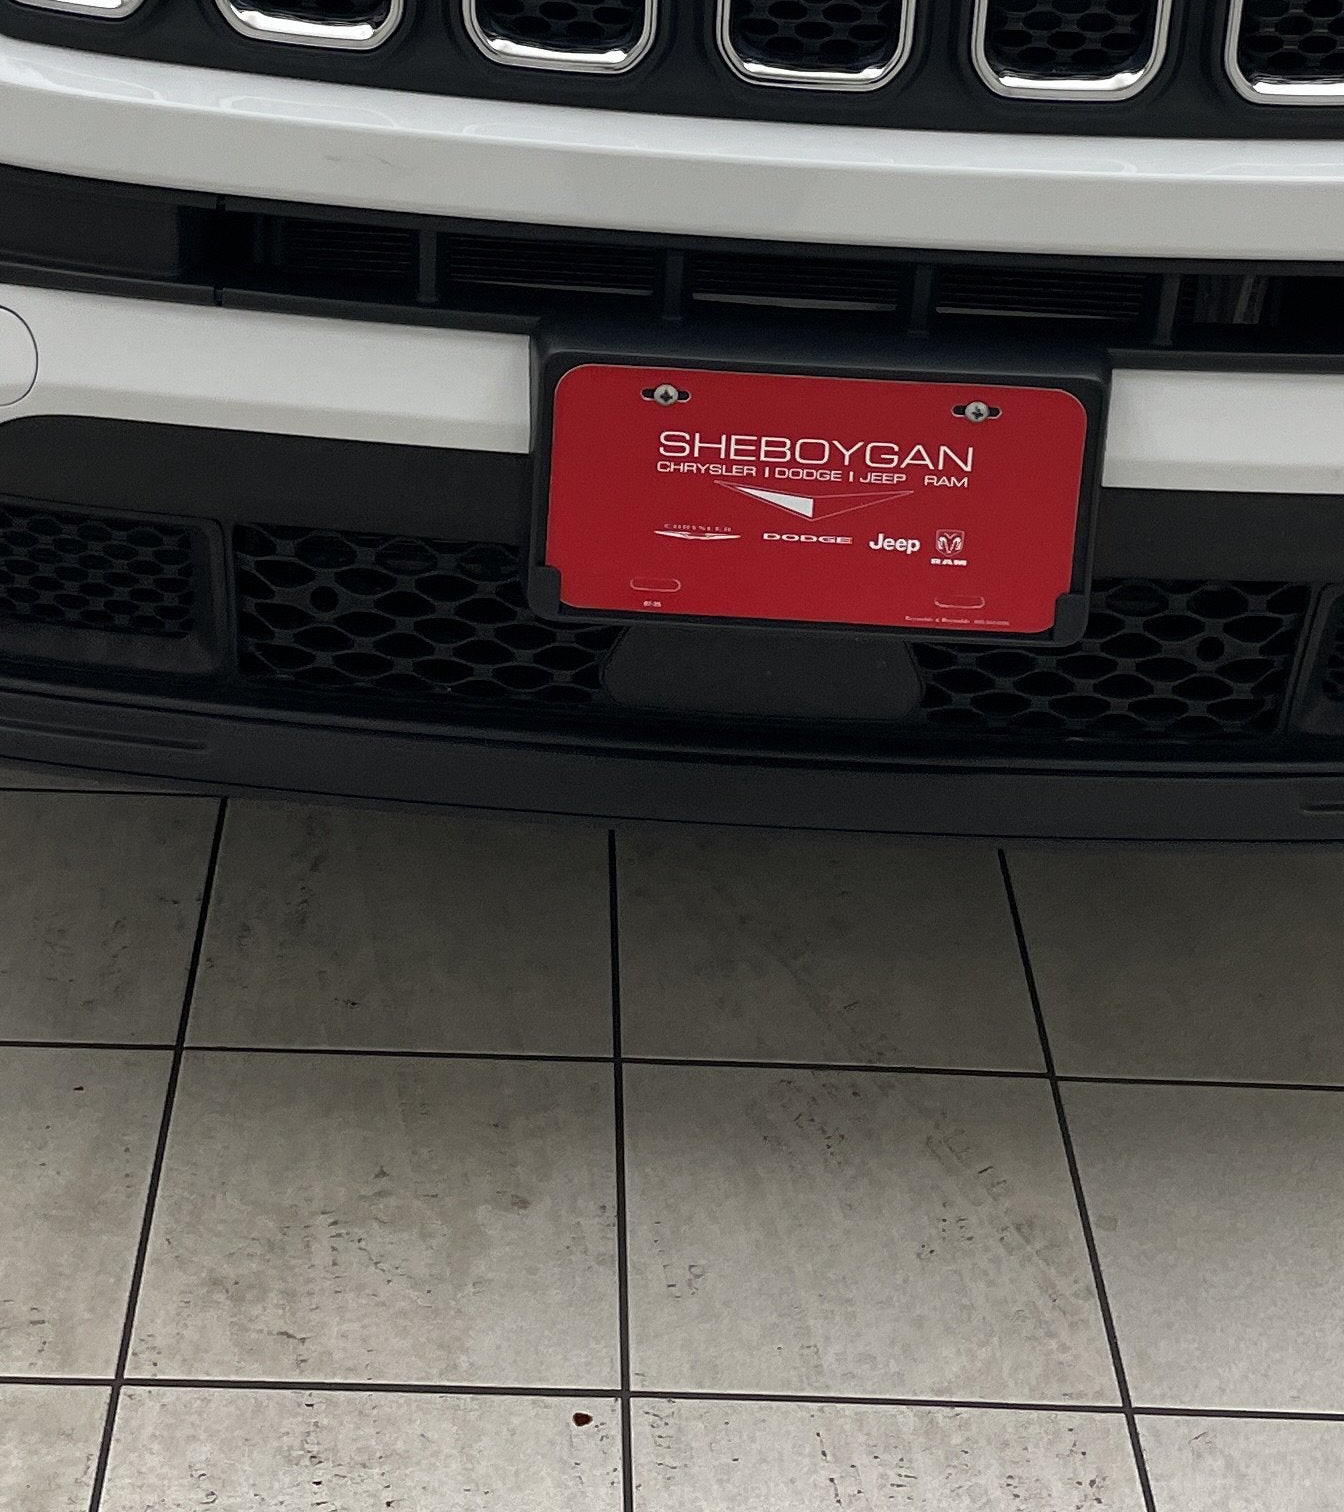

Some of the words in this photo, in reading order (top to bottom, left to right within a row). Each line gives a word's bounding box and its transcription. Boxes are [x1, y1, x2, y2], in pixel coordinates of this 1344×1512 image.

[658, 430, 974, 473] SHEBOYGAN
[656, 461, 756, 477] CHRYSLER
[775, 467, 842, 482] DODGE
[859, 472, 906, 484] JEEP
[924, 474, 968, 488] RAM
[763, 532, 853, 545] DODGE
[868, 533, 921, 555] Jeep
[930, 557, 968, 567] RAM
